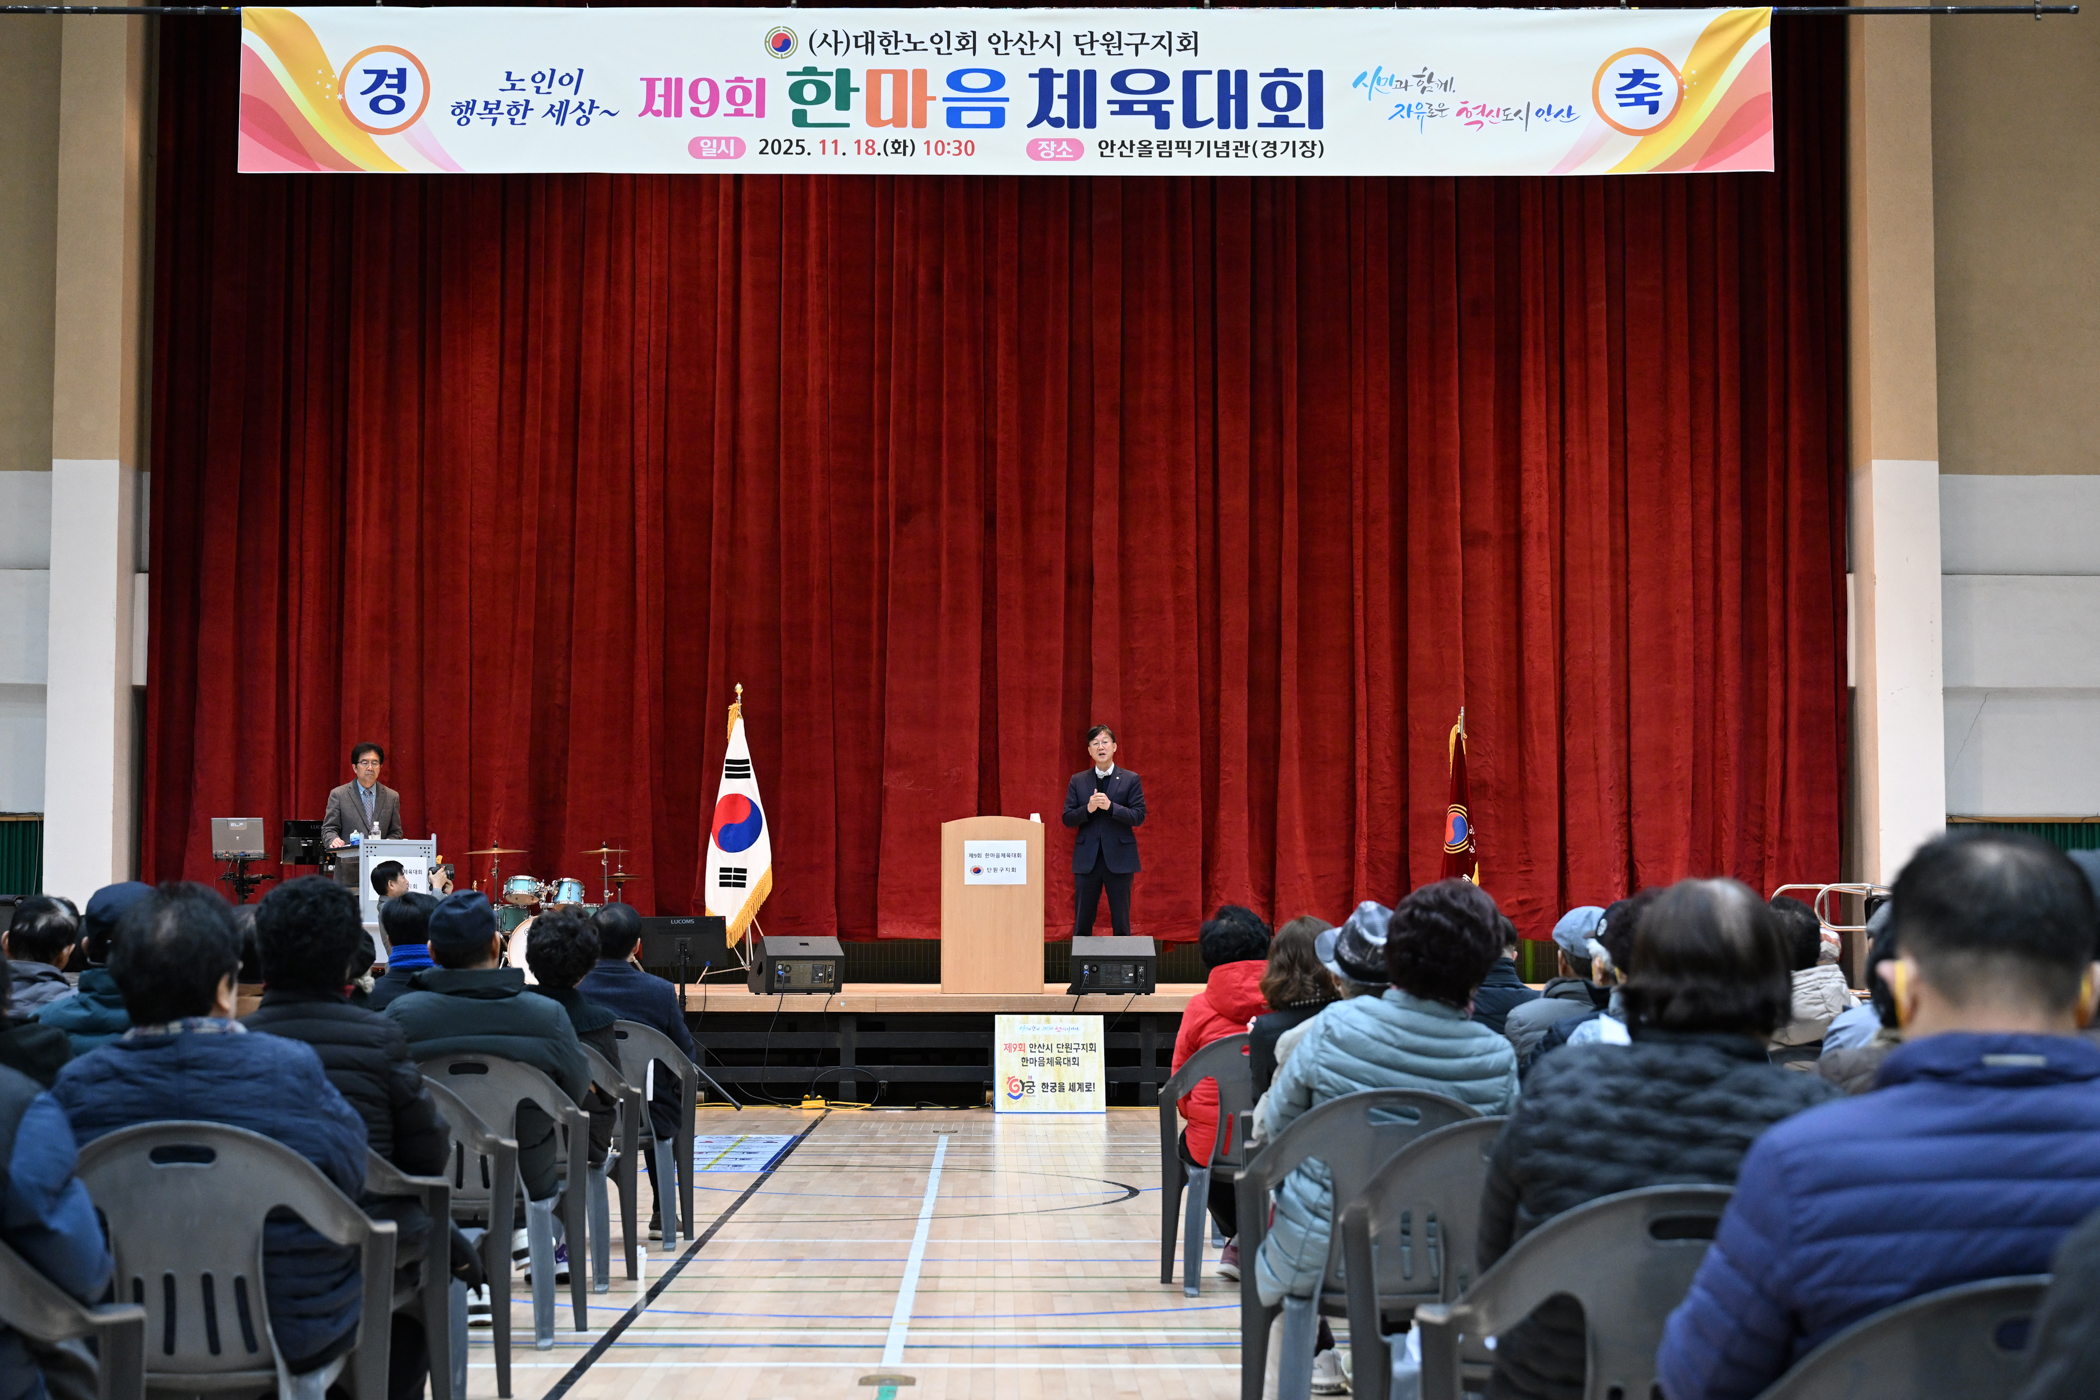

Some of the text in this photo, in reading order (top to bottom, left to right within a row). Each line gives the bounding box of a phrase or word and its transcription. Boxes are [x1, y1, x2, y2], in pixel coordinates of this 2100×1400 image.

[808, 28, 1200, 58] (사)대한노인회 안산시 단원구지회
[360, 67, 408, 115] 경
[498, 68, 585, 96] 노인이
[1352, 65, 1413, 101] 시민과
[1614, 68, 1663, 115] 축
[638, 66, 1324, 130] 제9회 한마음 체육대회
[450, 99, 620, 127] 행복한 세상~
[1388, 100, 1581, 134] 자유로운 혁신도시 안산
[699, 139, 735, 157] 일시
[758, 139, 976, 157] 2025. 11. 18.(화) 10:30
[1037, 140, 1074, 159] 장소
[1098, 139, 1325, 159] 안산올림픽기념관(경기장)
[1003, 1042, 1097, 1054] 제9회 안산시 단원구지회
[1021, 1056, 1080, 1067] 한마음체육대회
[1041, 1082, 1096, 1093] 한궁을 세계로!
